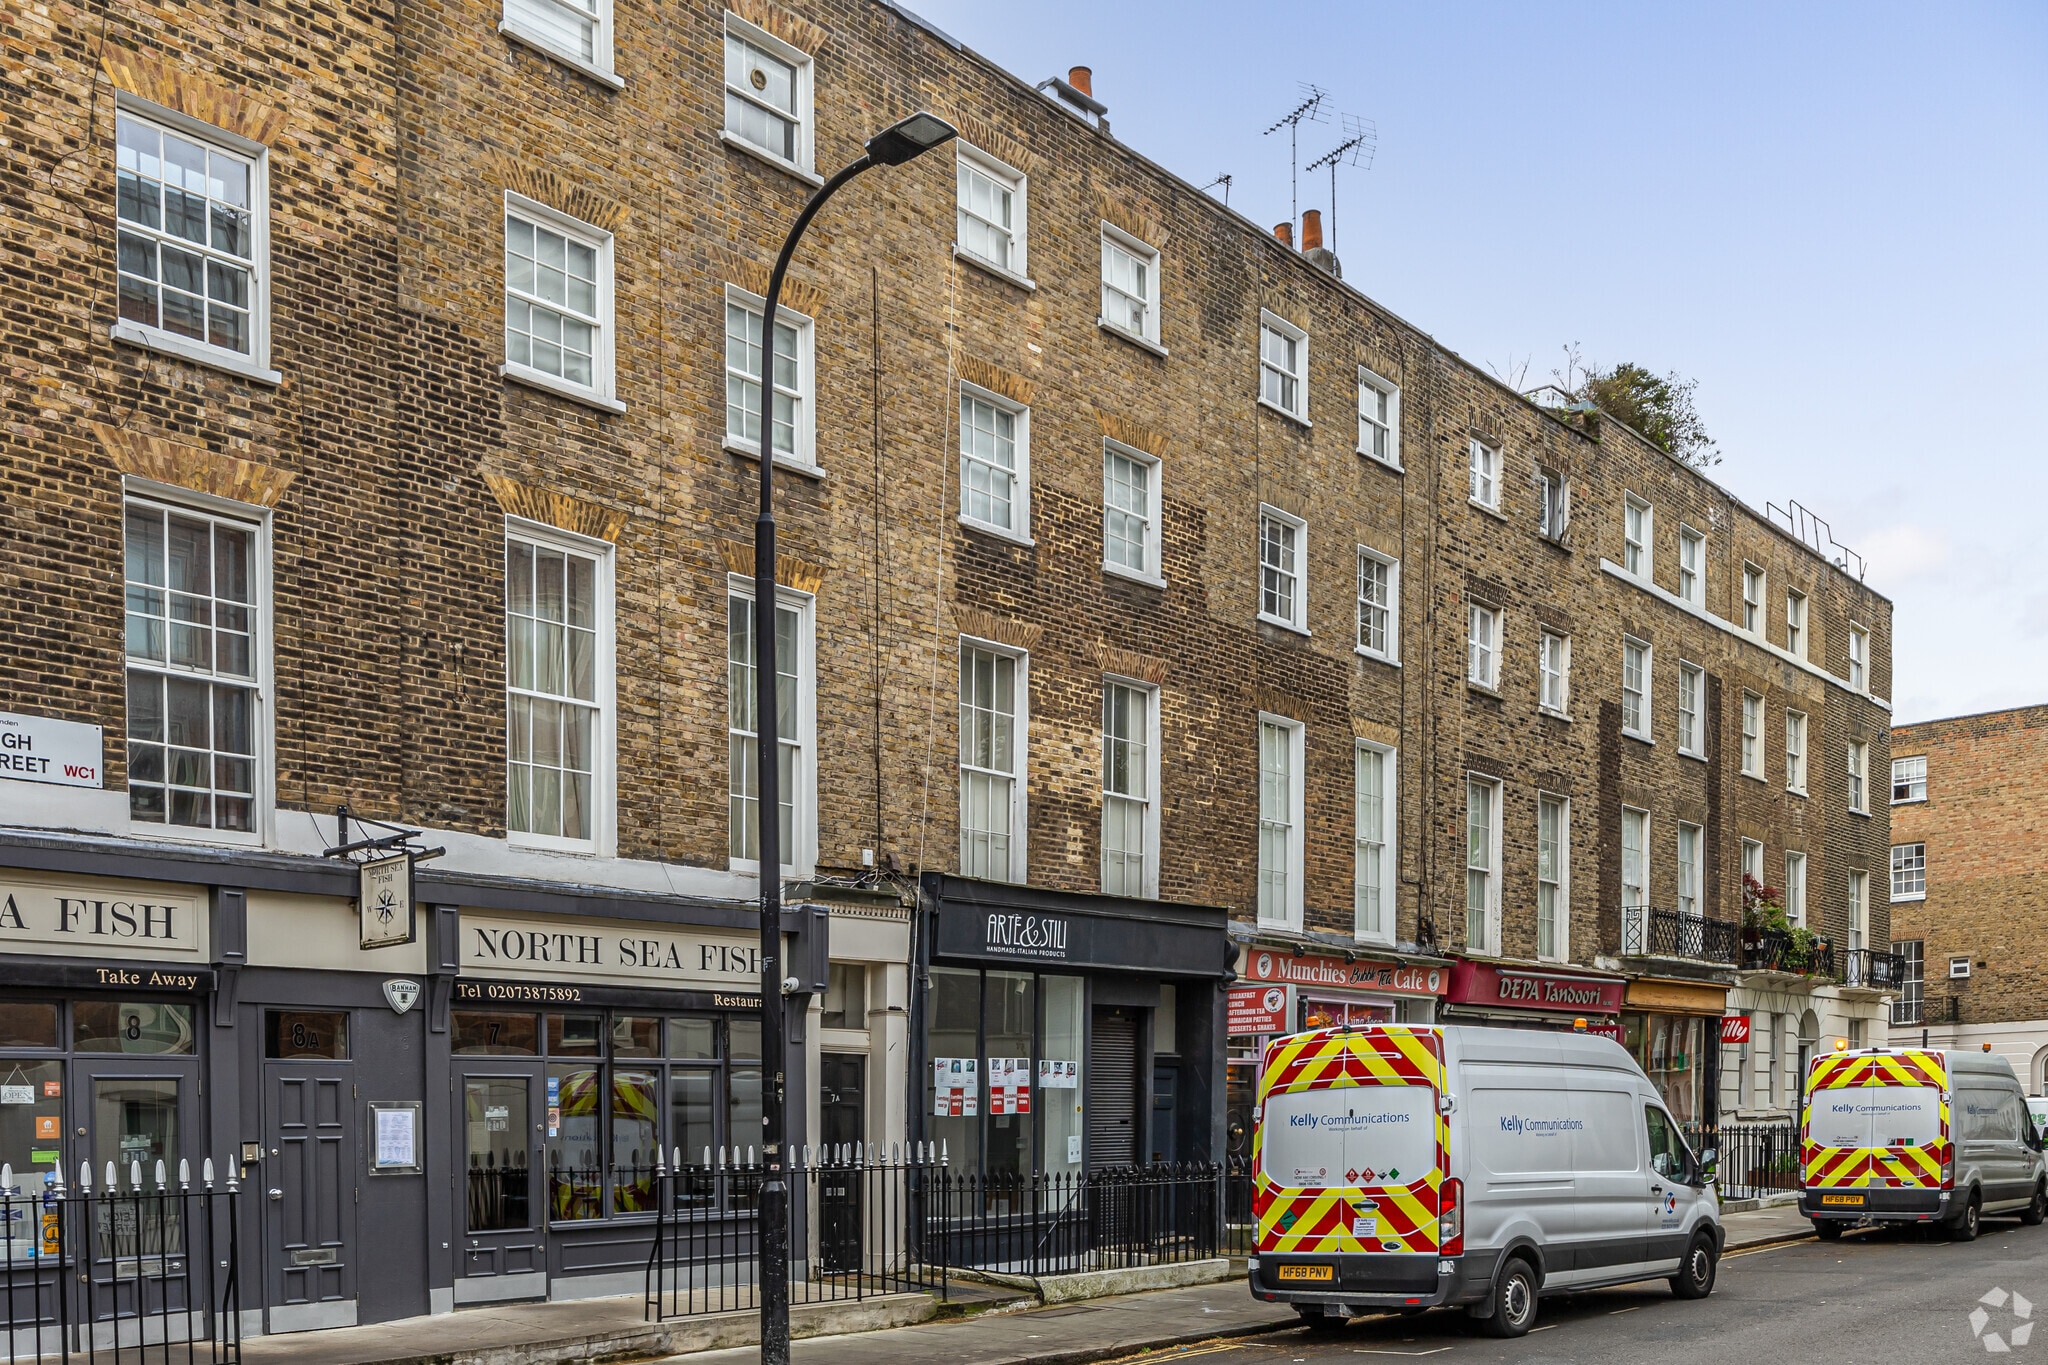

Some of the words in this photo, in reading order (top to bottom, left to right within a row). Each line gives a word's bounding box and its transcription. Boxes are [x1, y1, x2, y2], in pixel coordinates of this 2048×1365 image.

[1, 733, 31, 751] GH
[0, 753, 50, 774] REET
[64, 764, 95, 779] WC1
[368, 865, 389, 876] NORTH
[390, 863, 403, 872] SEA
[378, 874, 393, 884] FISH
[54, 897, 178, 939] FISH
[473, 928, 603, 965] NORTH
[619, 938, 685, 970] SEA
[986, 945, 1016, 954] HANDMADE
[1039, 950, 1066, 958] PRODUCTS
[96, 968, 140, 985] Take
[149, 971, 198, 990] Away
[1277, 957, 1346, 984] Munchies
[1349, 966, 1376, 985] Bubble
[1377, 968, 1392, 987] Tea
[1394, 969, 1423, 990] Café
[391, 984, 417, 992] BANHAM
[457, 984, 482, 998] Tel
[488, 984, 581, 1001] 02073875892
[1499, 978, 1539, 1000] DEPA
[1544, 981, 1601, 1005] Tandoori
[126, 1015, 141, 1041] 8
[292, 1023, 320, 1048] 8A
[489, 1023, 501, 1045] 7
[1722, 1020, 1748, 1041] illy
[830, 1094, 841, 1103] 7A
[1832, 1104, 1854, 1114] Kelly
[1855, 1104, 1921, 1112] Communications
[1290, 1113, 1319, 1129] Kelly
[1321, 1112, 1410, 1126] Communications
[1500, 1115, 1523, 1135] Kelly
[1525, 1117, 1583, 1131] Communications
[1283, 1267, 1307, 1277] HF68
[1309, 1267, 1329, 1278] PNV
